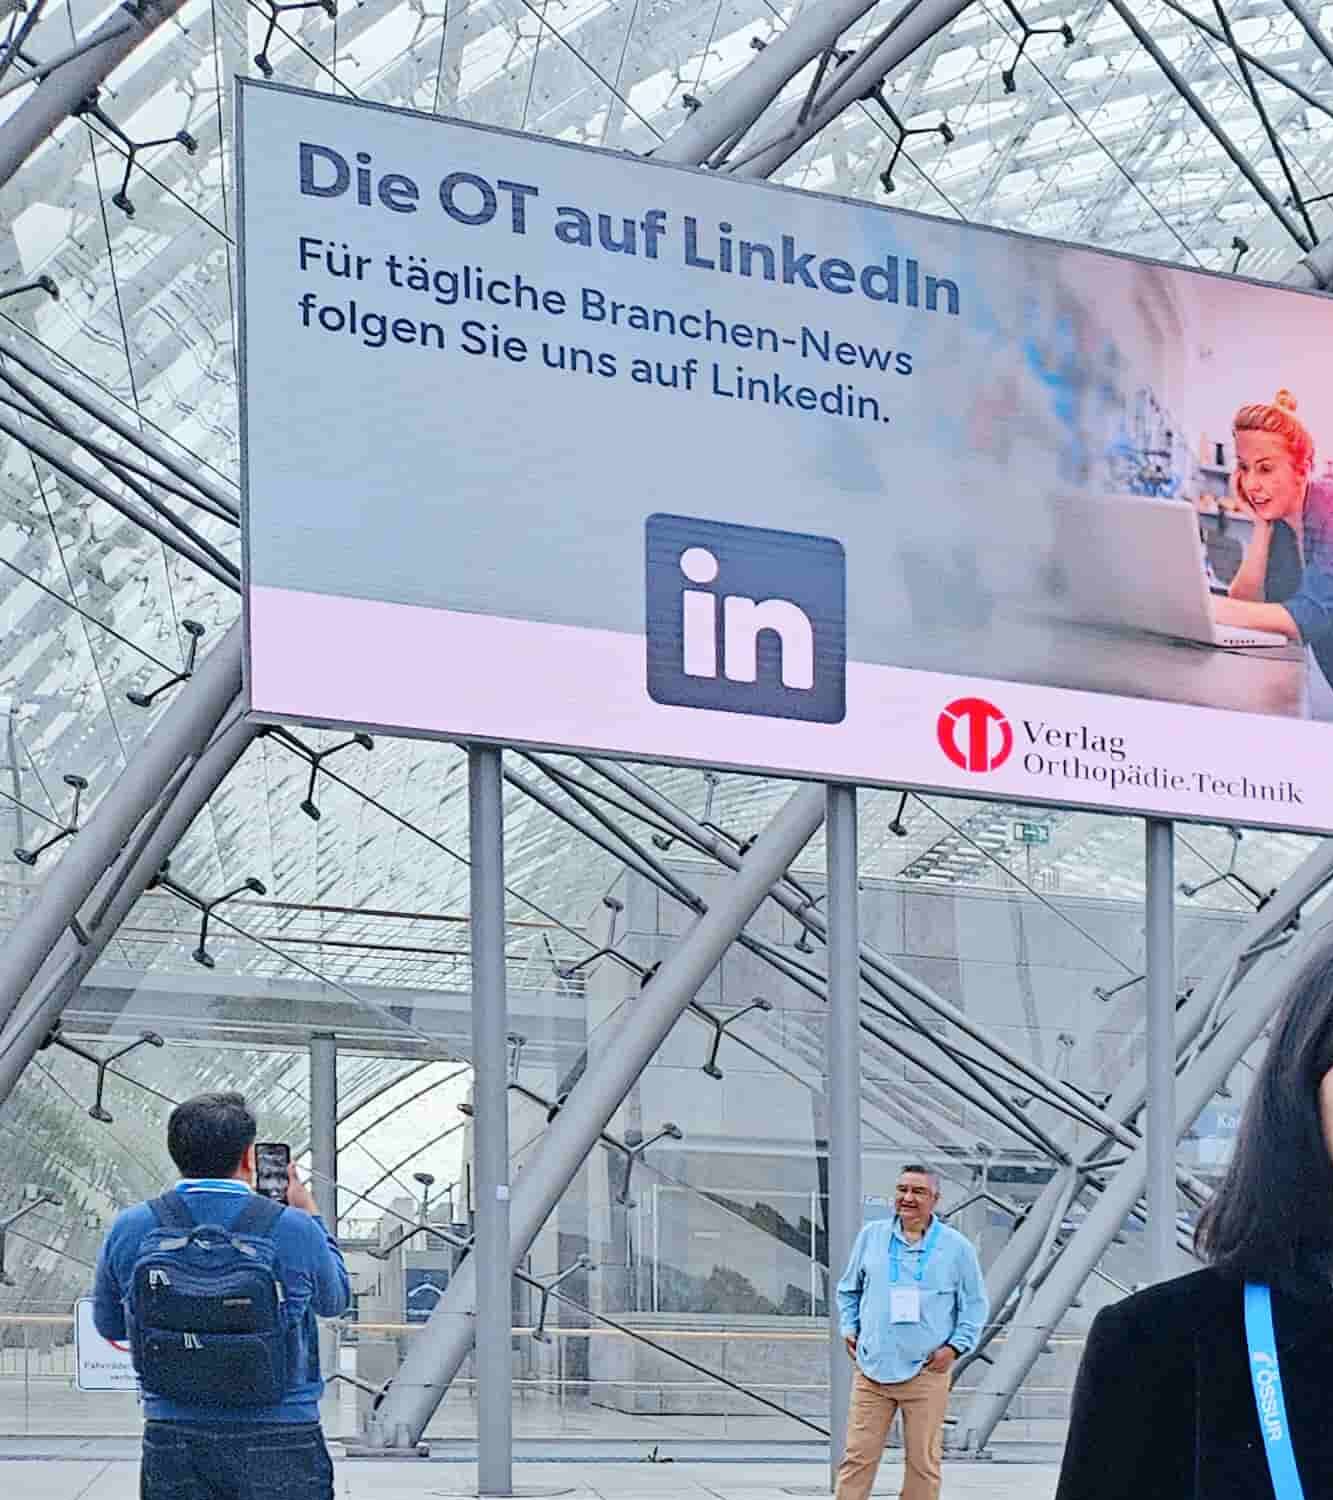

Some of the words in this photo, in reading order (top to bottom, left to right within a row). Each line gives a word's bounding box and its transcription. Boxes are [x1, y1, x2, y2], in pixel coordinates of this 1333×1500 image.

[298, 141, 420, 214] Die
[438, 171, 540, 236] OT
[553, 205, 668, 260] auf
[683, 215, 961, 316] LinkedIn
[297, 292, 446, 350] folgen
[460, 319, 529, 363] Sie
[541, 342, 617, 378] uns
[630, 357, 698, 391] auf
[711, 362, 891, 423] Linkedin.
[298, 236, 373, 281] Für
[385, 254, 567, 315] tägliche
[580, 287, 914, 376] Branchen-News
[680, 546, 814, 690] in
[1022, 719, 1127, 762] Verlag
[1022, 752, 1304, 805] Orthopädie.Technik
